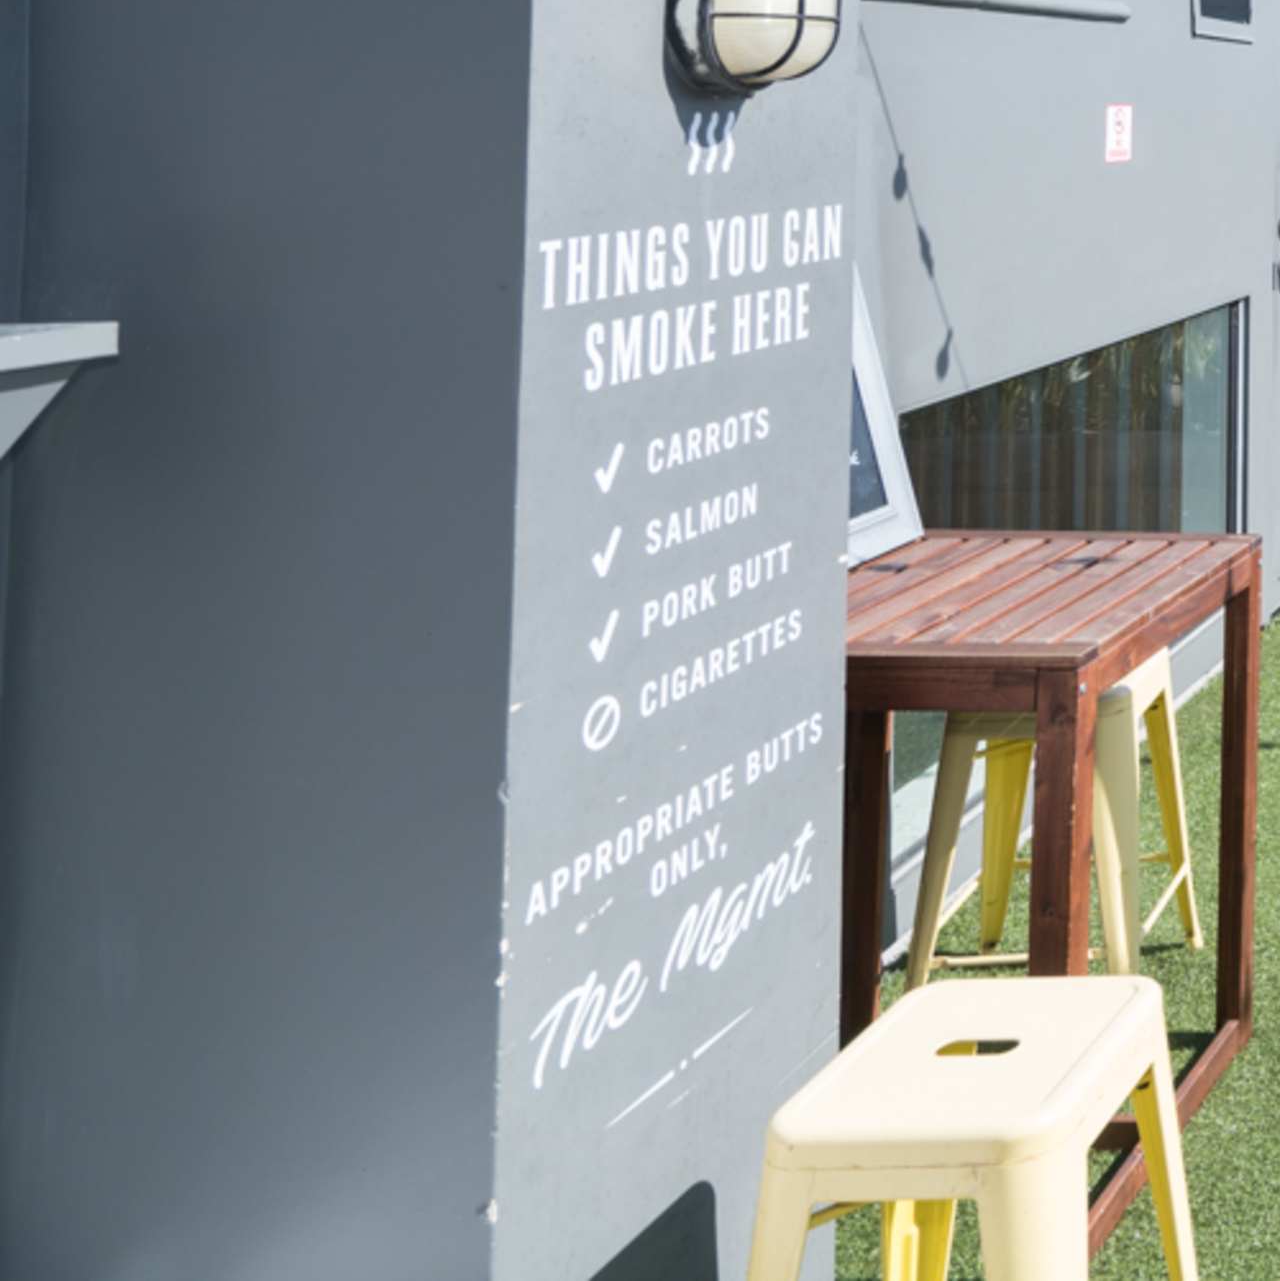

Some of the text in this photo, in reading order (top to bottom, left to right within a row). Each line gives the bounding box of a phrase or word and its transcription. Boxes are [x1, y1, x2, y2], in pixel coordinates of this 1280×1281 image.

[540, 204, 843, 310] THINGS YOU CAN
[584, 282, 810, 392] SMOKE HERE
[647, 407, 769, 474] CARROTS
[645, 483, 758, 555] SALMON
[642, 541, 793, 637] PORK BUTT
[639, 609, 802, 718] CIGARETTES
[525, 712, 823, 926] APPROPRIATE BUTTS
[650, 823, 728, 897] ONLY,
[529, 821, 815, 1090] The Mgmt.
